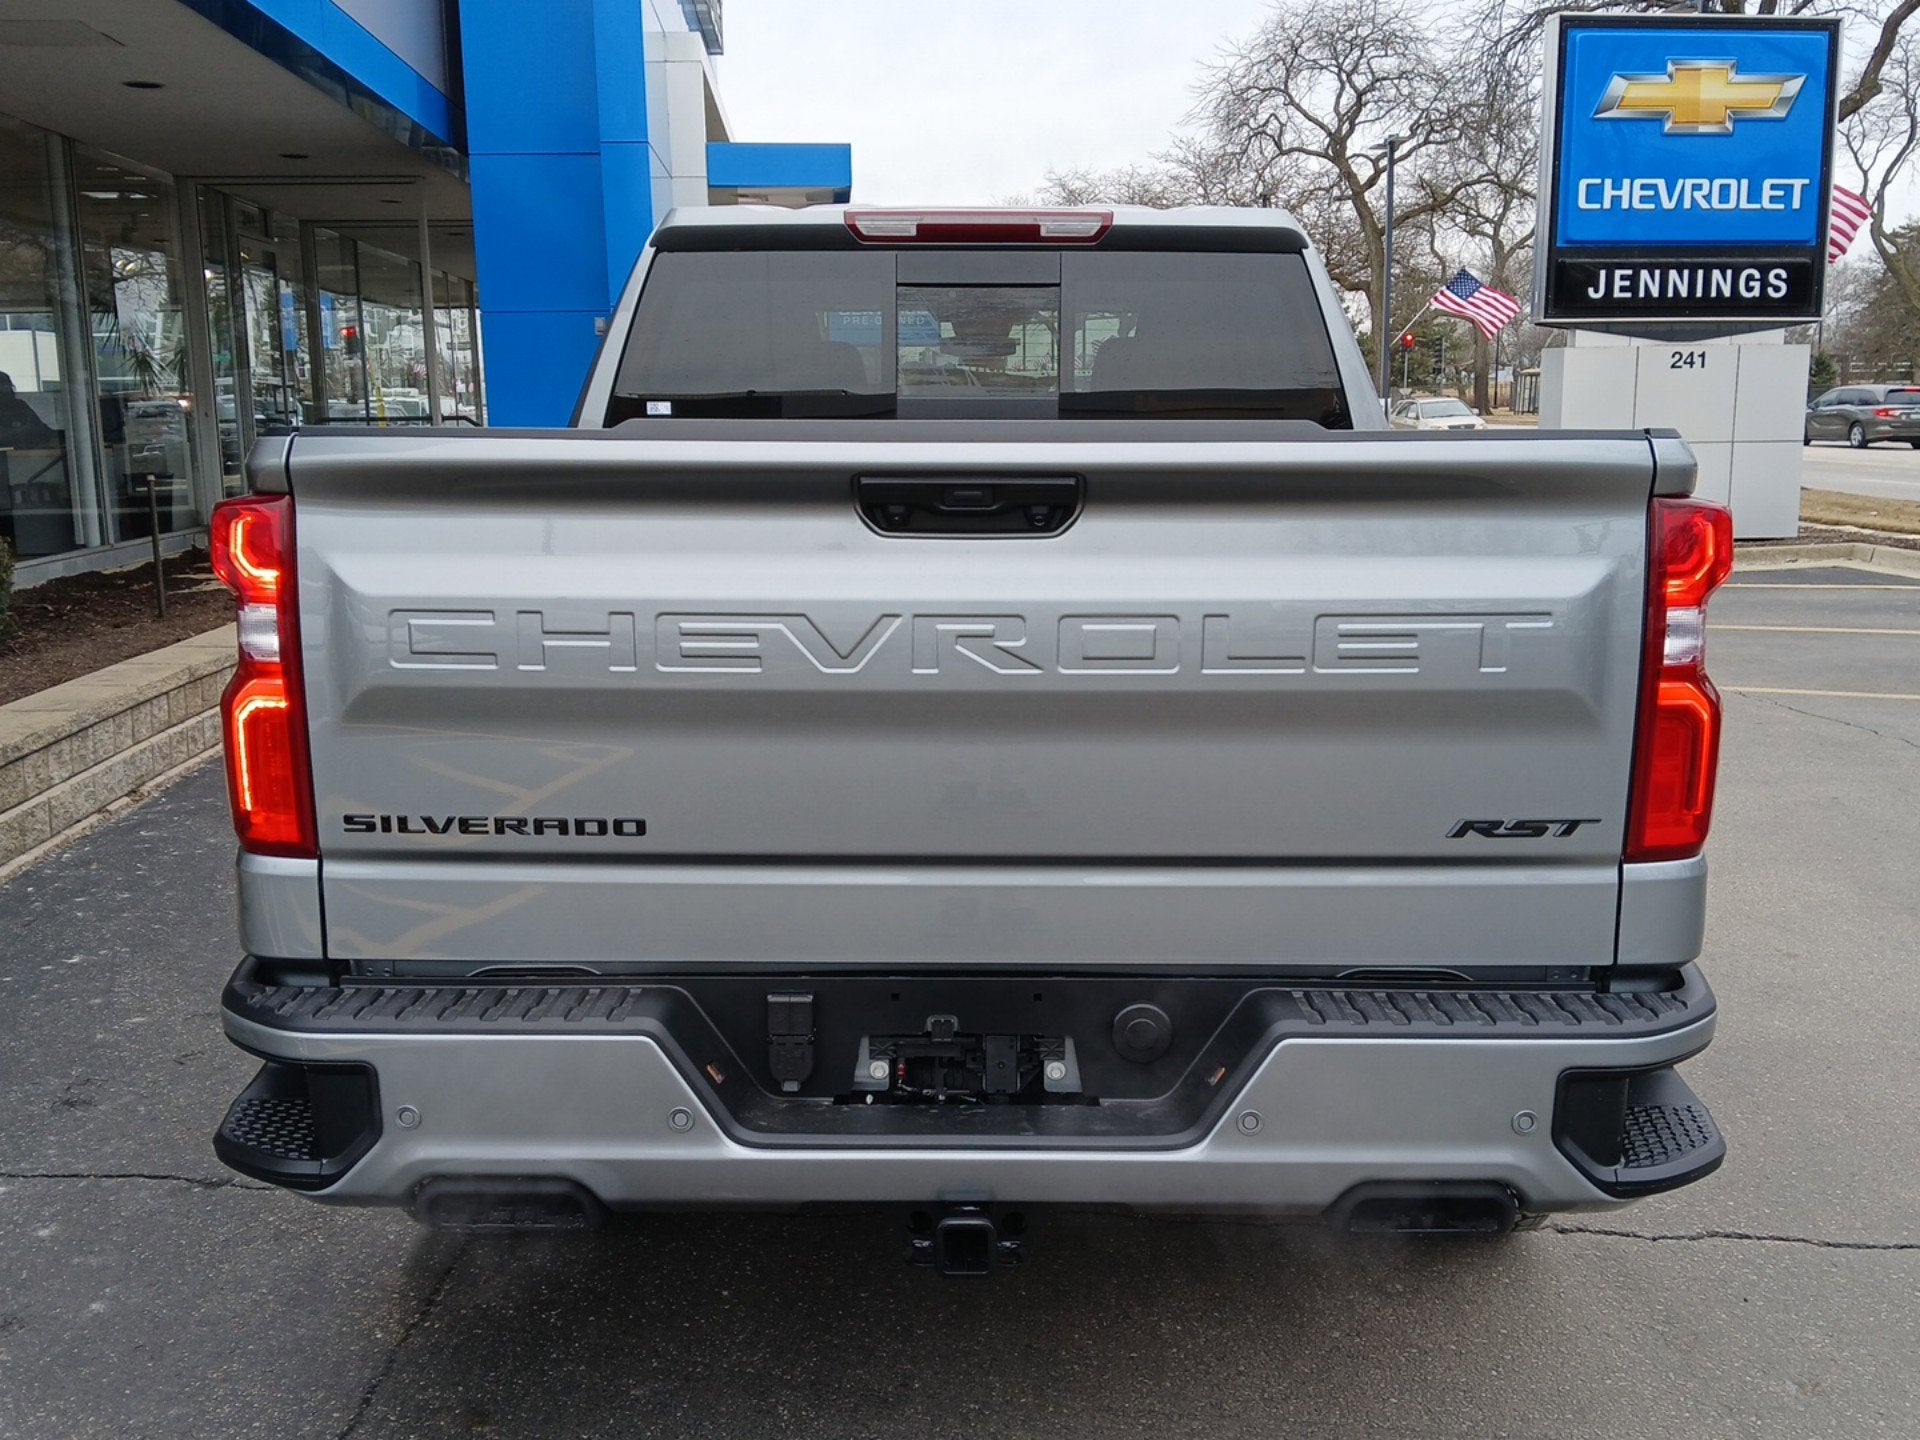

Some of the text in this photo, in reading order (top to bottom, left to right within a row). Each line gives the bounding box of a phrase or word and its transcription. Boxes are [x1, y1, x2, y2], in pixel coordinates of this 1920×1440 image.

[1577, 178, 1811, 210] CHEVROLET
[1587, 267, 1789, 299] JENNINGS
[843, 315, 925, 325] PRE-ONED
[1669, 350, 1707, 370] 241
[388, 608, 1554, 676] CHEVROLET
[342, 813, 647, 838] SILVERADO
[1445, 818, 1602, 838] RST
